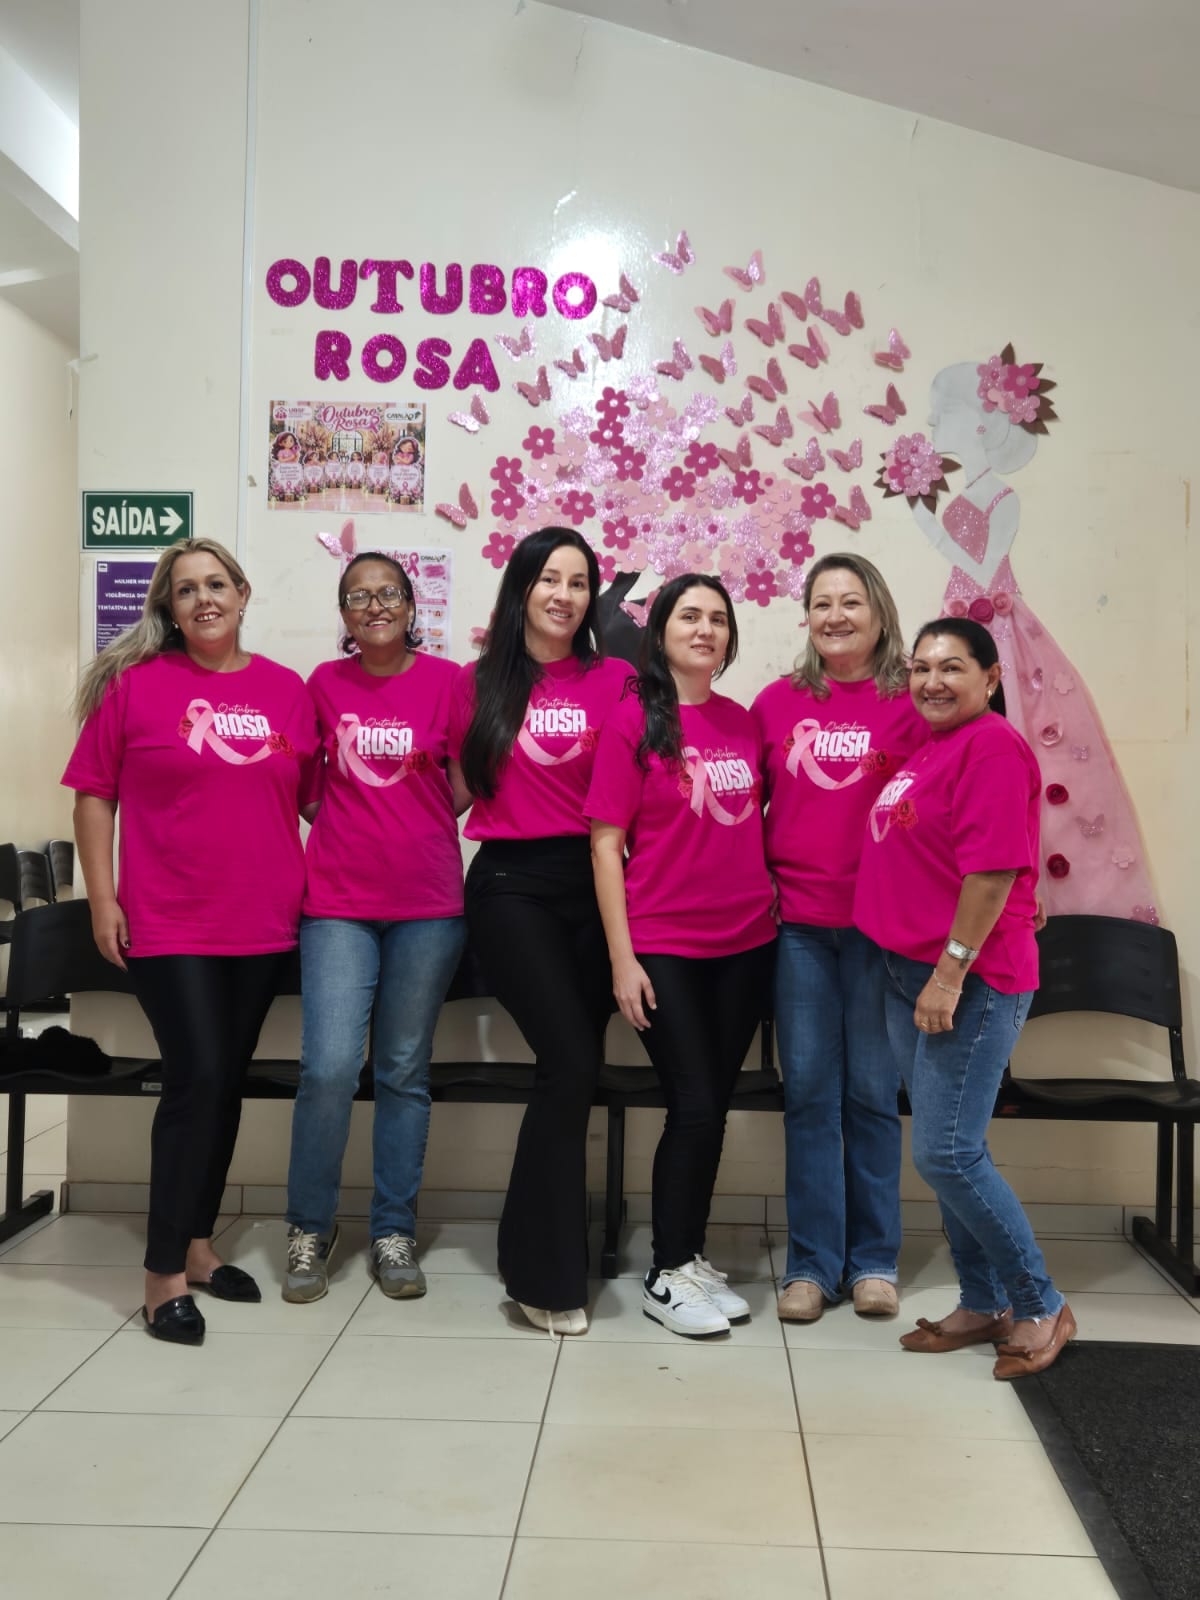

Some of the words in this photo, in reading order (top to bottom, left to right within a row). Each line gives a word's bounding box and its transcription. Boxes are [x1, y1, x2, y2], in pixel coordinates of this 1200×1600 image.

[266, 256, 597, 320] OUTUBRO
[314, 330, 500, 392] ROSA
[322, 404, 377, 423] Outubro
[333, 417, 368, 431] Rosa
[92, 500, 157, 536] SAÍDA
[212, 713, 271, 737] ROSA
[529, 707, 587, 734] ROSA
[356, 726, 413, 756] ROSA
[813, 731, 872, 757] ROSA
[703, 758, 754, 792] ROSA
